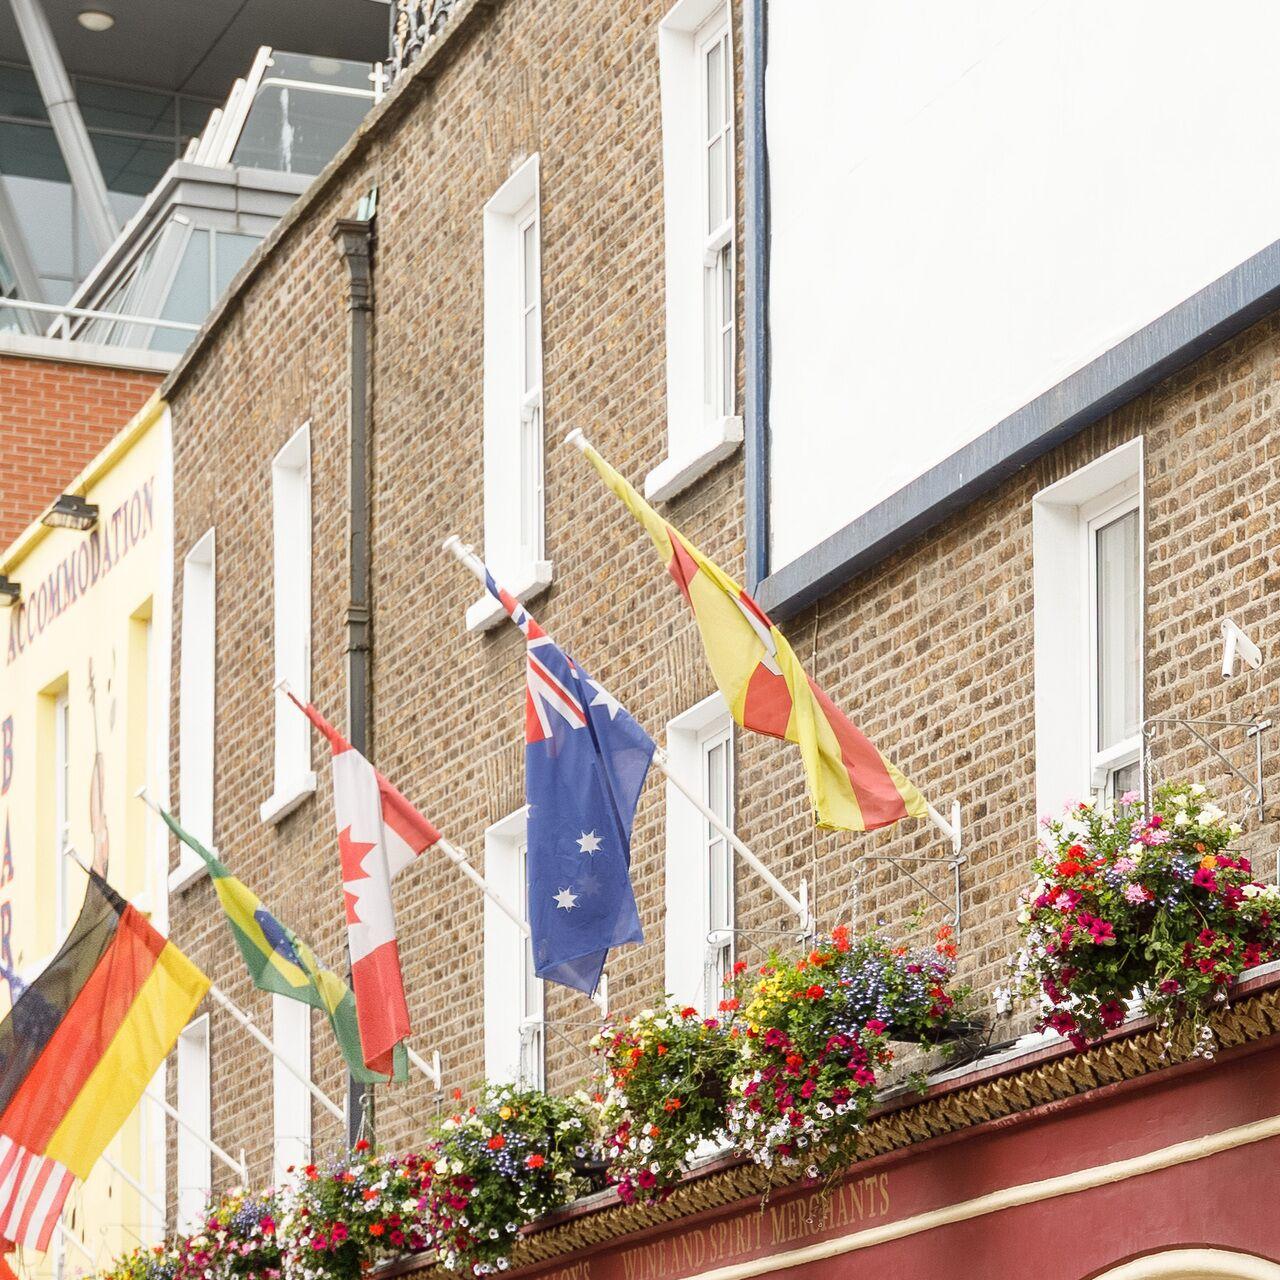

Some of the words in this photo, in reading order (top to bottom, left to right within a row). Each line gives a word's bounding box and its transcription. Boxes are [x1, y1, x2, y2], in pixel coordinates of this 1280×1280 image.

[7, 476, 155, 667] ACCOMMODATION
[669, 1229, 706, 1274] AND
[709, 1211, 764, 1262] SPIRIT
[769, 1171, 890, 1246] MERCHANTS
